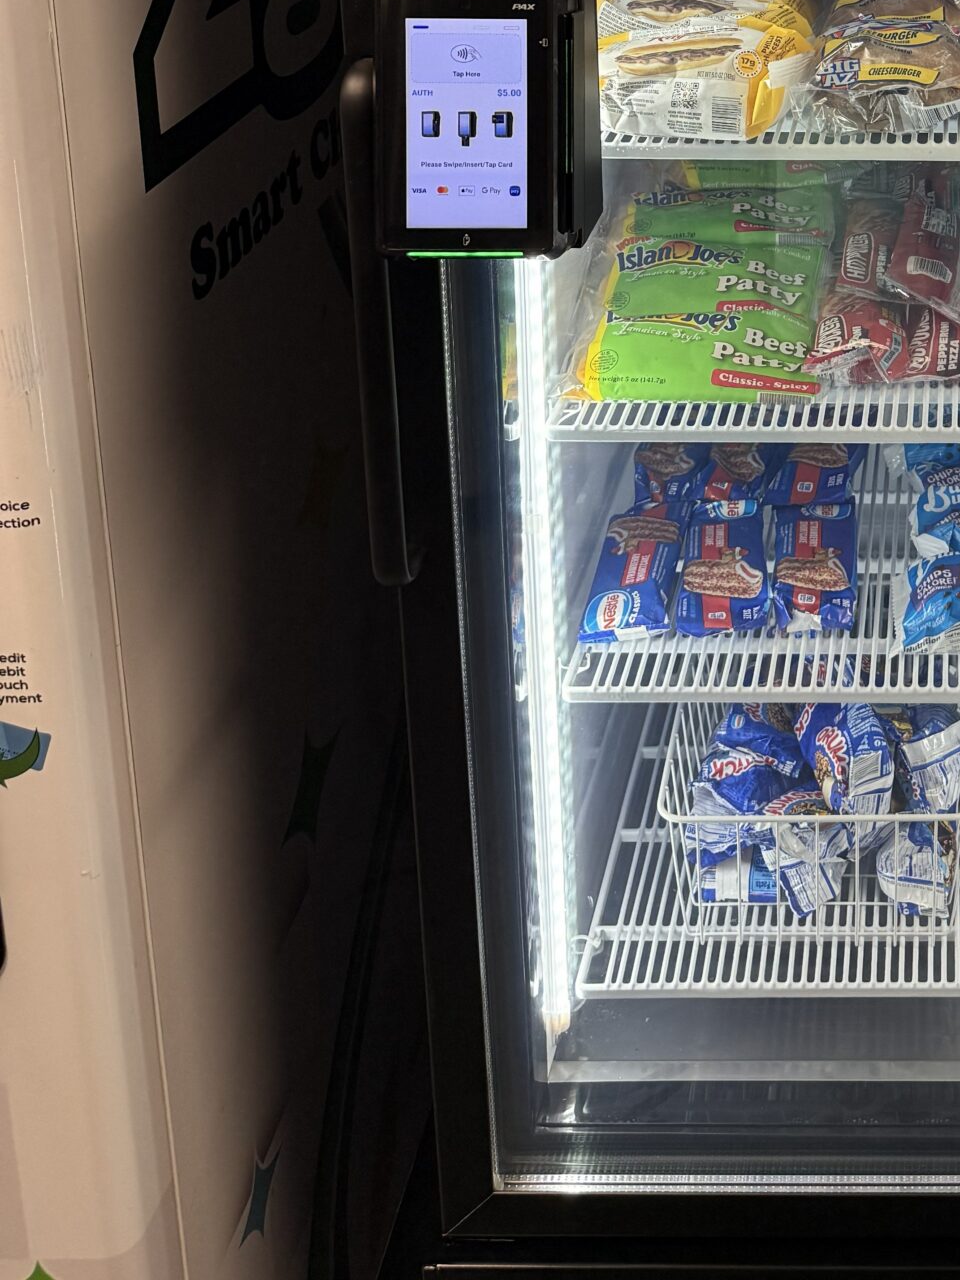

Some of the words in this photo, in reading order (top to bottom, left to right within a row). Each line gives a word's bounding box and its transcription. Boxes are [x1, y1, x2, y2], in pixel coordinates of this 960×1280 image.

[512, 3, 536, 11] PAX
[868, 68, 922, 78] CHEESEBURGER
[411, 89, 434, 97] AUTH
[497, 88, 522, 98] $5.00
[443, 161, 497, 169] Swipe/Insert/Tap
[190, 150, 303, 300] Smart
[748, 260, 806, 286] Beef
[716, 275, 802, 306] Patty
[744, 328, 808, 358] Beef
[712, 342, 803, 372] Patty
[949, 339, 960, 370] PIZZA
[602, 375, 624, 384] weight
[719, 372, 763, 387] Classic
[773, 381, 810, 391] Spicy
[0, 500, 30, 511] oice
[917, 569, 953, 593] CHIPS
